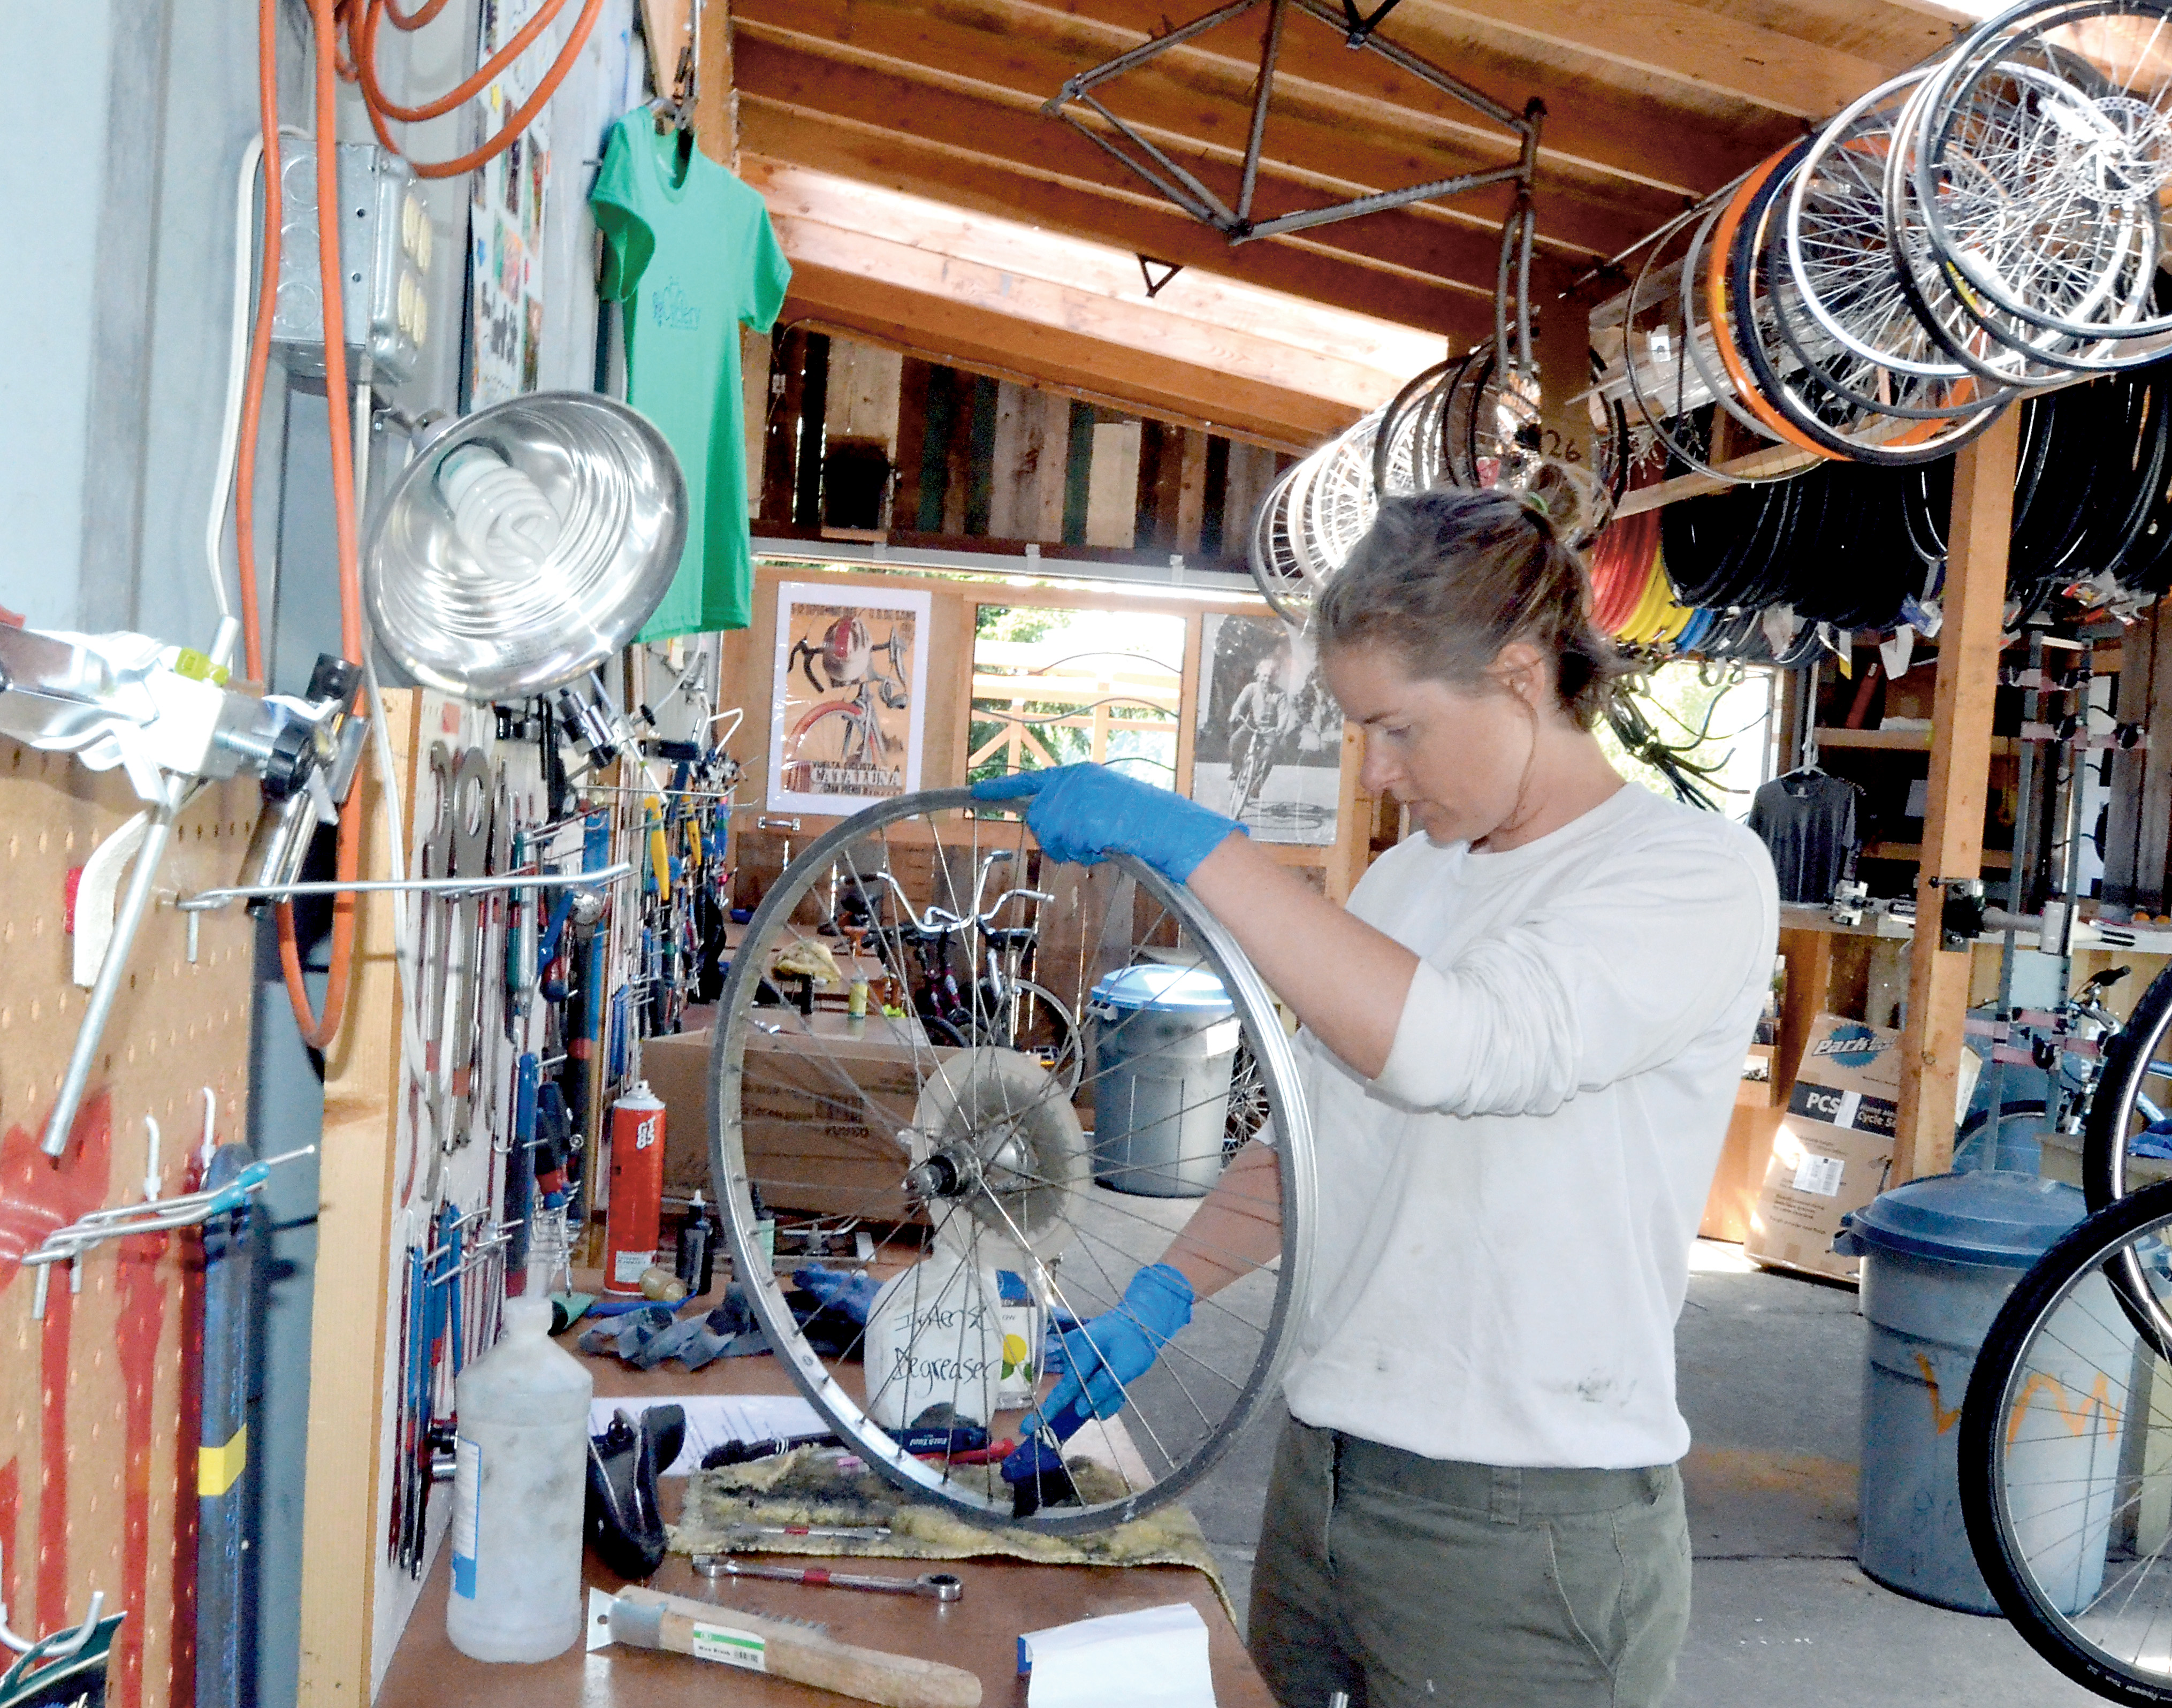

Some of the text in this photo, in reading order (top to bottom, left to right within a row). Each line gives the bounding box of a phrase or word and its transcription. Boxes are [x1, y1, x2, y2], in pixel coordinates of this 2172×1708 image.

[1546, 430, 1581, 463] 26
[1812, 1037, 1870, 1056] Park
[1806, 1093, 1841, 1114] PCS
[636, 1133, 656, 1150] 85
[892, 1346, 1001, 1399] Degreaser
